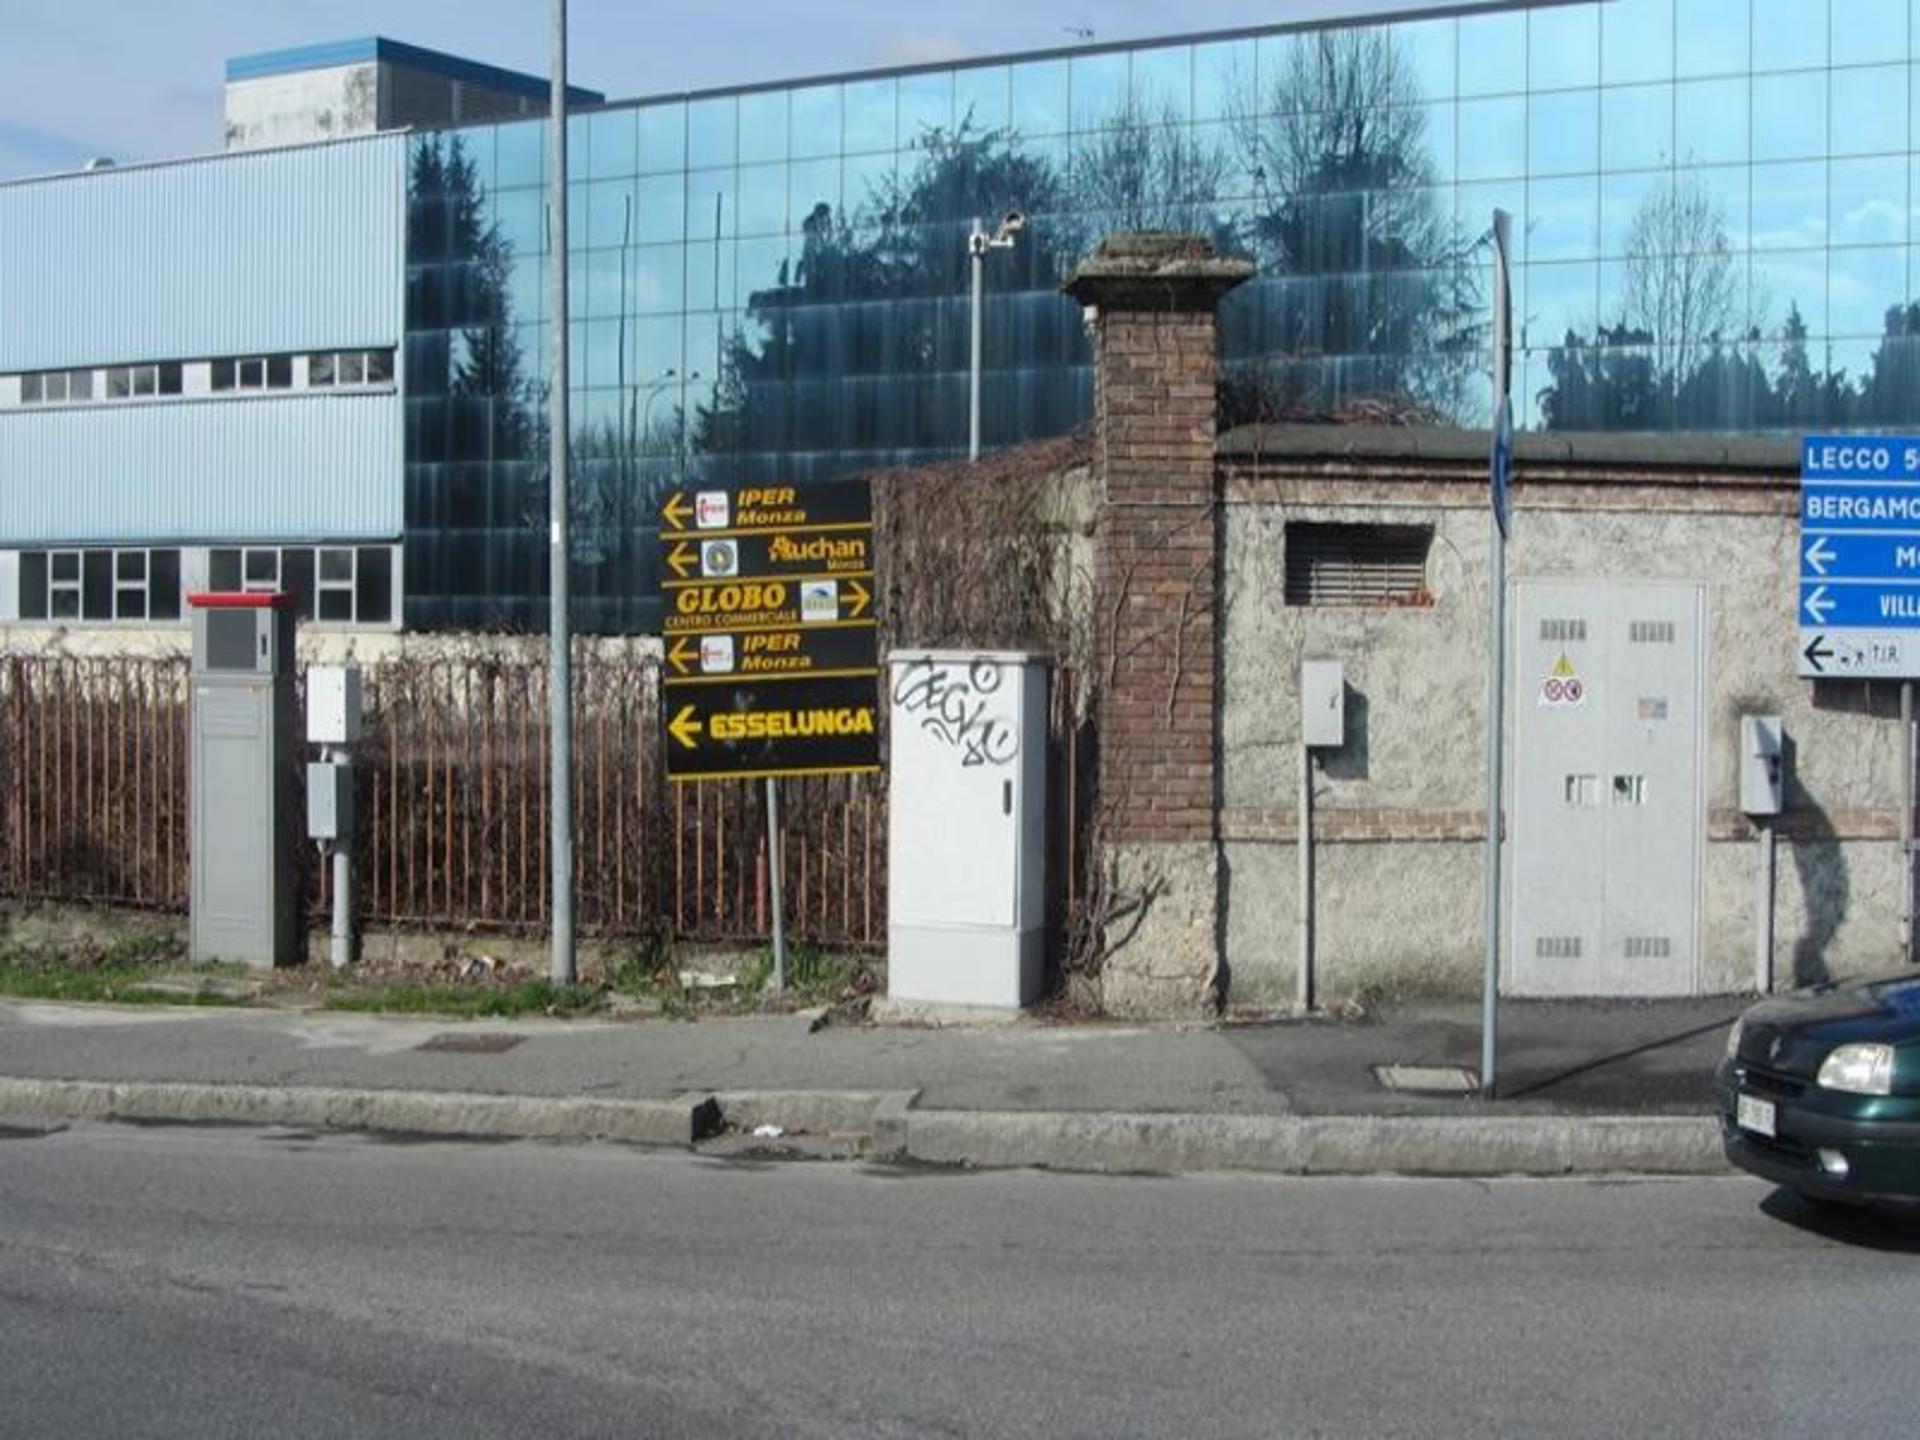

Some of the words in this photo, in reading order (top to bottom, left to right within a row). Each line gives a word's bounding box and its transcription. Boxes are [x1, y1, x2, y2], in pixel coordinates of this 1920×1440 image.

[1808, 447, 1889, 470] LECCO
[737, 487, 796, 506] IPER
[736, 510, 807, 525] Monza
[768, 534, 866, 562] Auchan
[1896, 546, 1920, 569] M
[676, 583, 787, 614] GLOBO
[1880, 594, 1920, 617] VILL
[743, 632, 801, 652] IPER
[741, 655, 813, 671] Monza
[710, 707, 874, 739] ESSELUNGA
